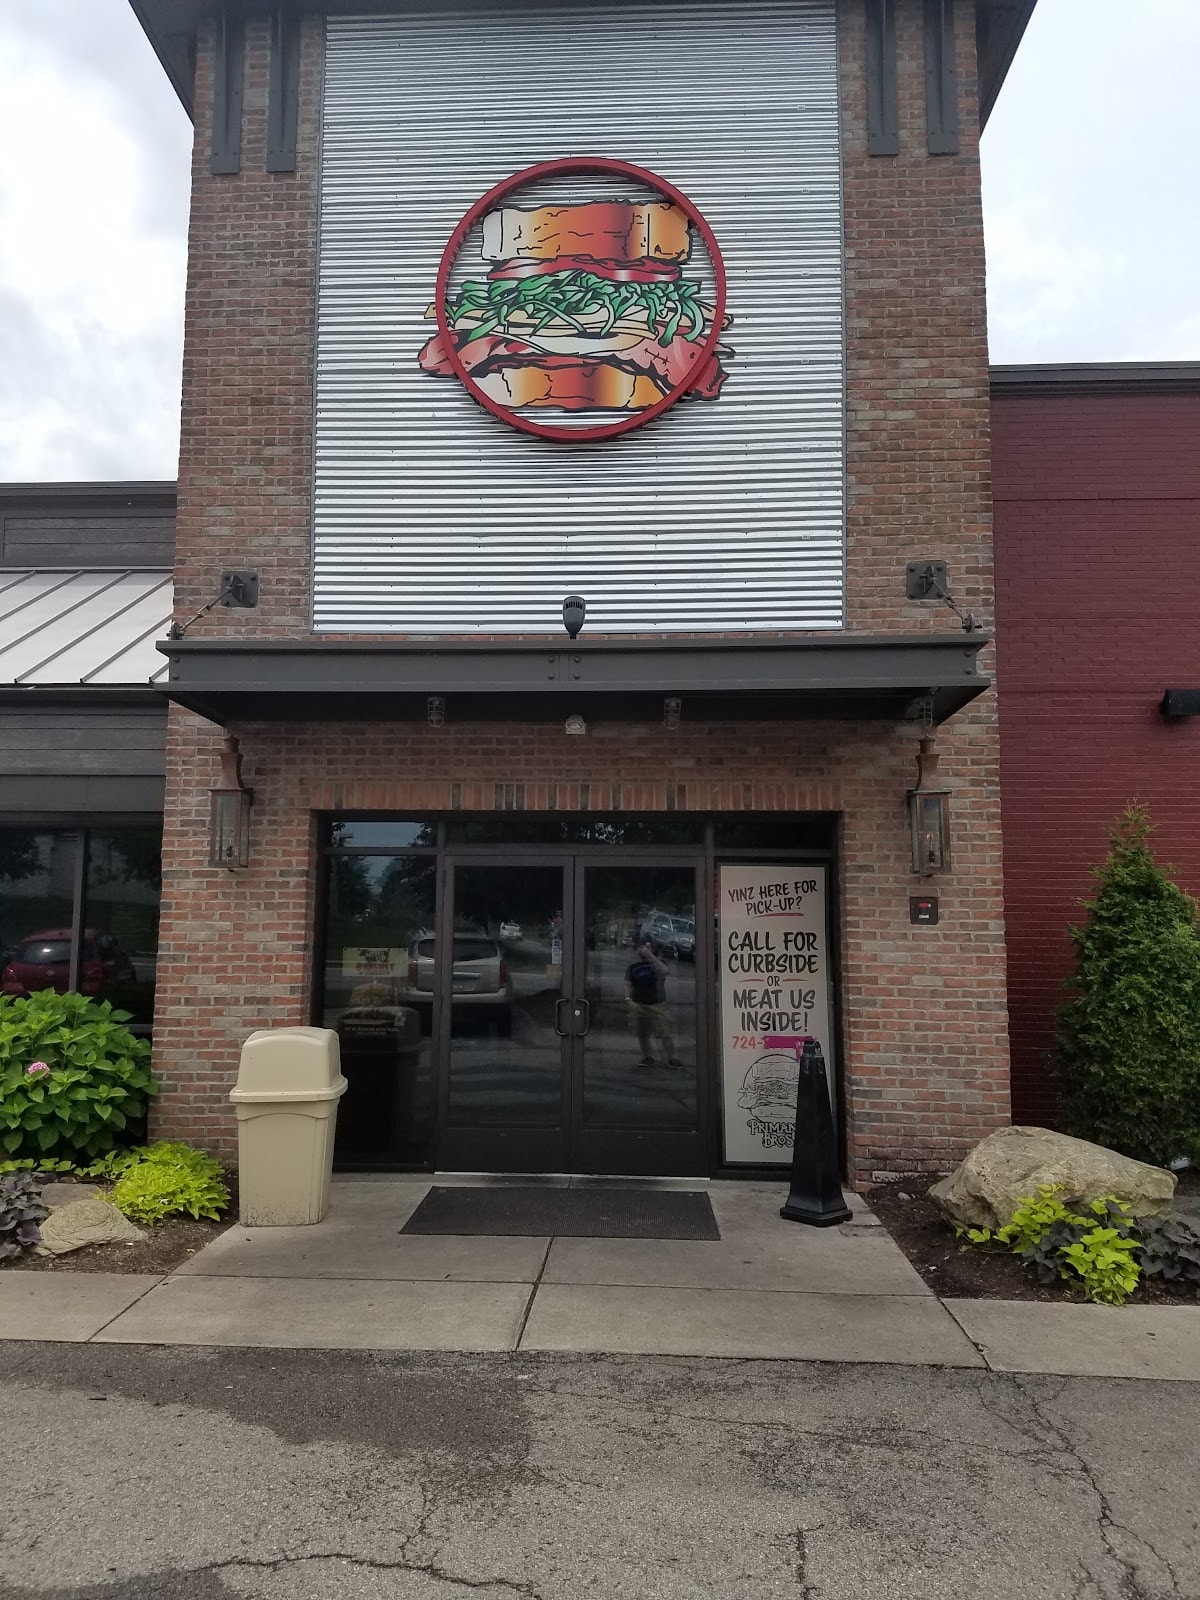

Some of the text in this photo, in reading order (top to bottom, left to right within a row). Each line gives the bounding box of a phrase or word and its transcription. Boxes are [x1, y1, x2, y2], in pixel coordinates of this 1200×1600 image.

[728, 879, 818, 903] YINZ HERE FOR
[745, 895, 803, 916] PICK-UP?
[728, 931, 818, 951] CALL FOR
[728, 952, 819, 974] CURBSIDE
[766, 975, 781, 987] OR
[733, 988, 816, 1010] MEAT US
[741, 1011, 809, 1033] INSIDE!
[746, 1118, 797, 1136] PRIMAN
